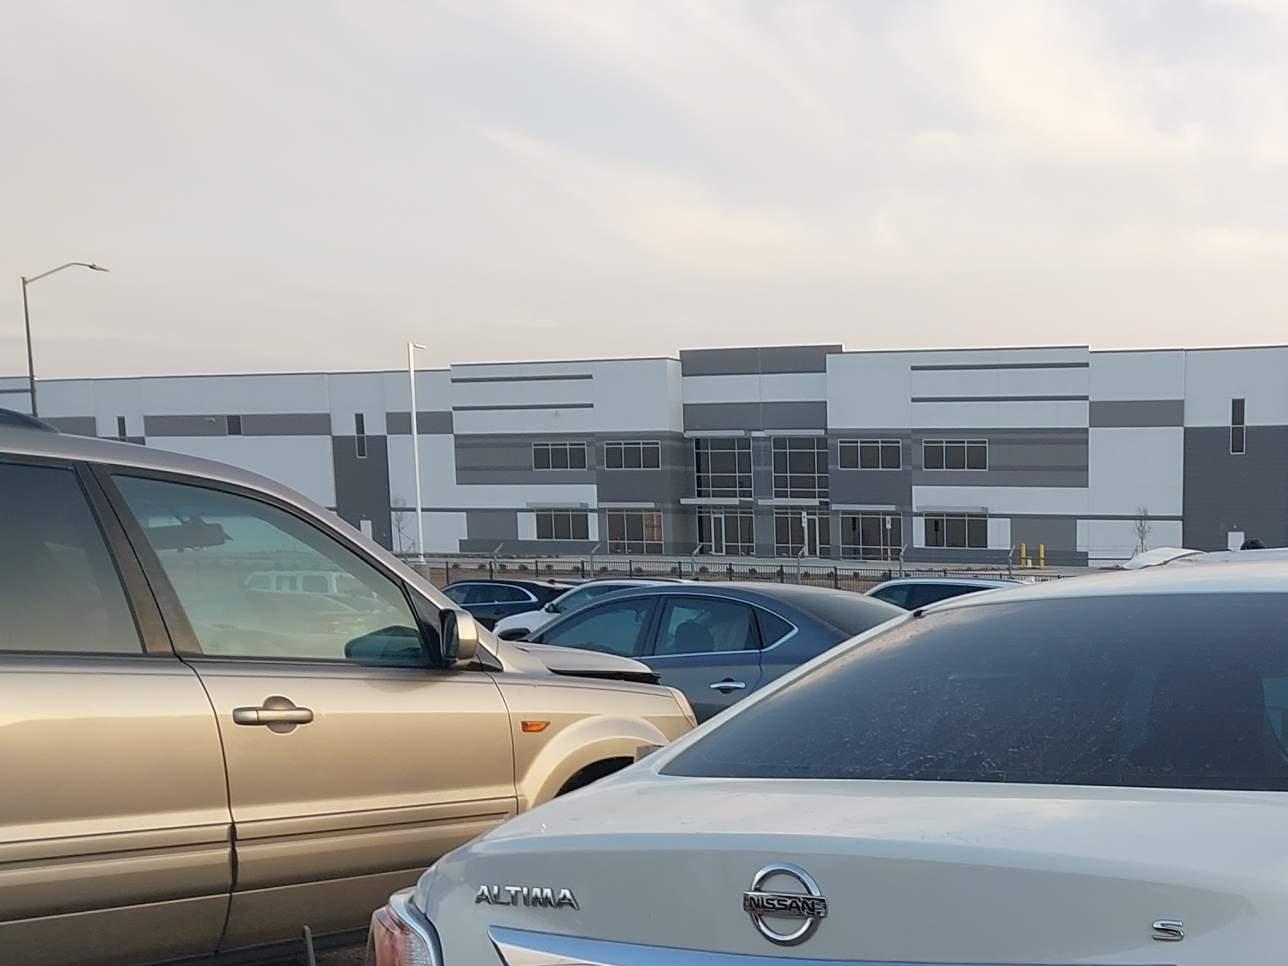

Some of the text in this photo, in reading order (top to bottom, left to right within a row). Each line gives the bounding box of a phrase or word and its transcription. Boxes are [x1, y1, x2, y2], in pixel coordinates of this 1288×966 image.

[475, 884, 580, 911] ALTIMA
[749, 896, 816, 913] NISSAN
[1152, 919, 1184, 942] S
